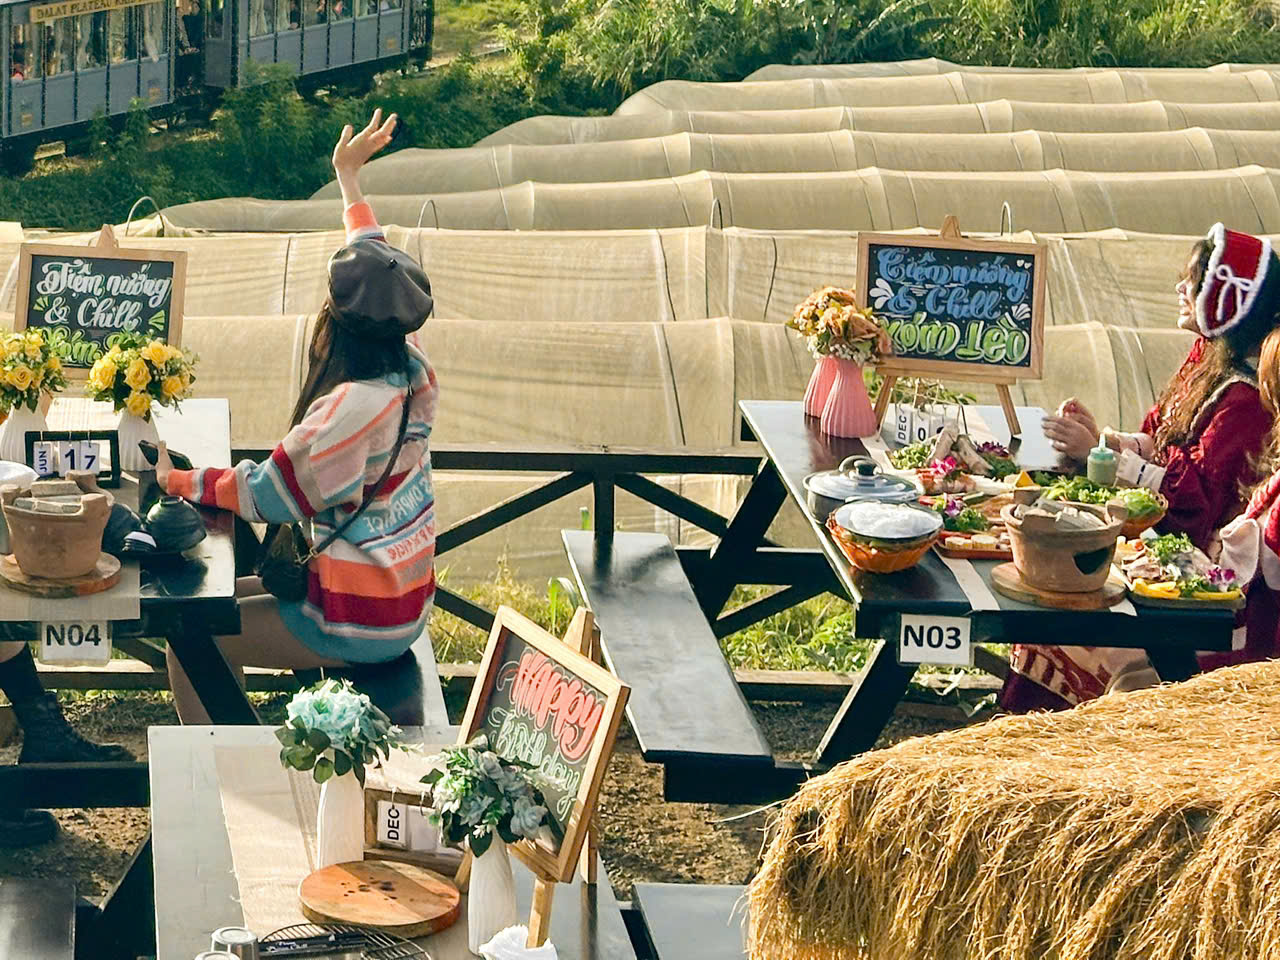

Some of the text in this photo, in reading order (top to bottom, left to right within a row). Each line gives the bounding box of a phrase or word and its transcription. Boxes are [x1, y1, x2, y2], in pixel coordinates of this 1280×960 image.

[36, 7, 67, 20] DALAT
[36, 259, 173, 308] Tiệm nướng
[44, 296, 141, 331] & Chill
[925, 286, 1002, 319] Chill
[898, 415, 907, 441] DEC
[38, 450, 48, 472] JUN
[45, 624, 101, 647] N04
[903, 624, 962, 650] N03
[386, 806, 401, 842] DEC
